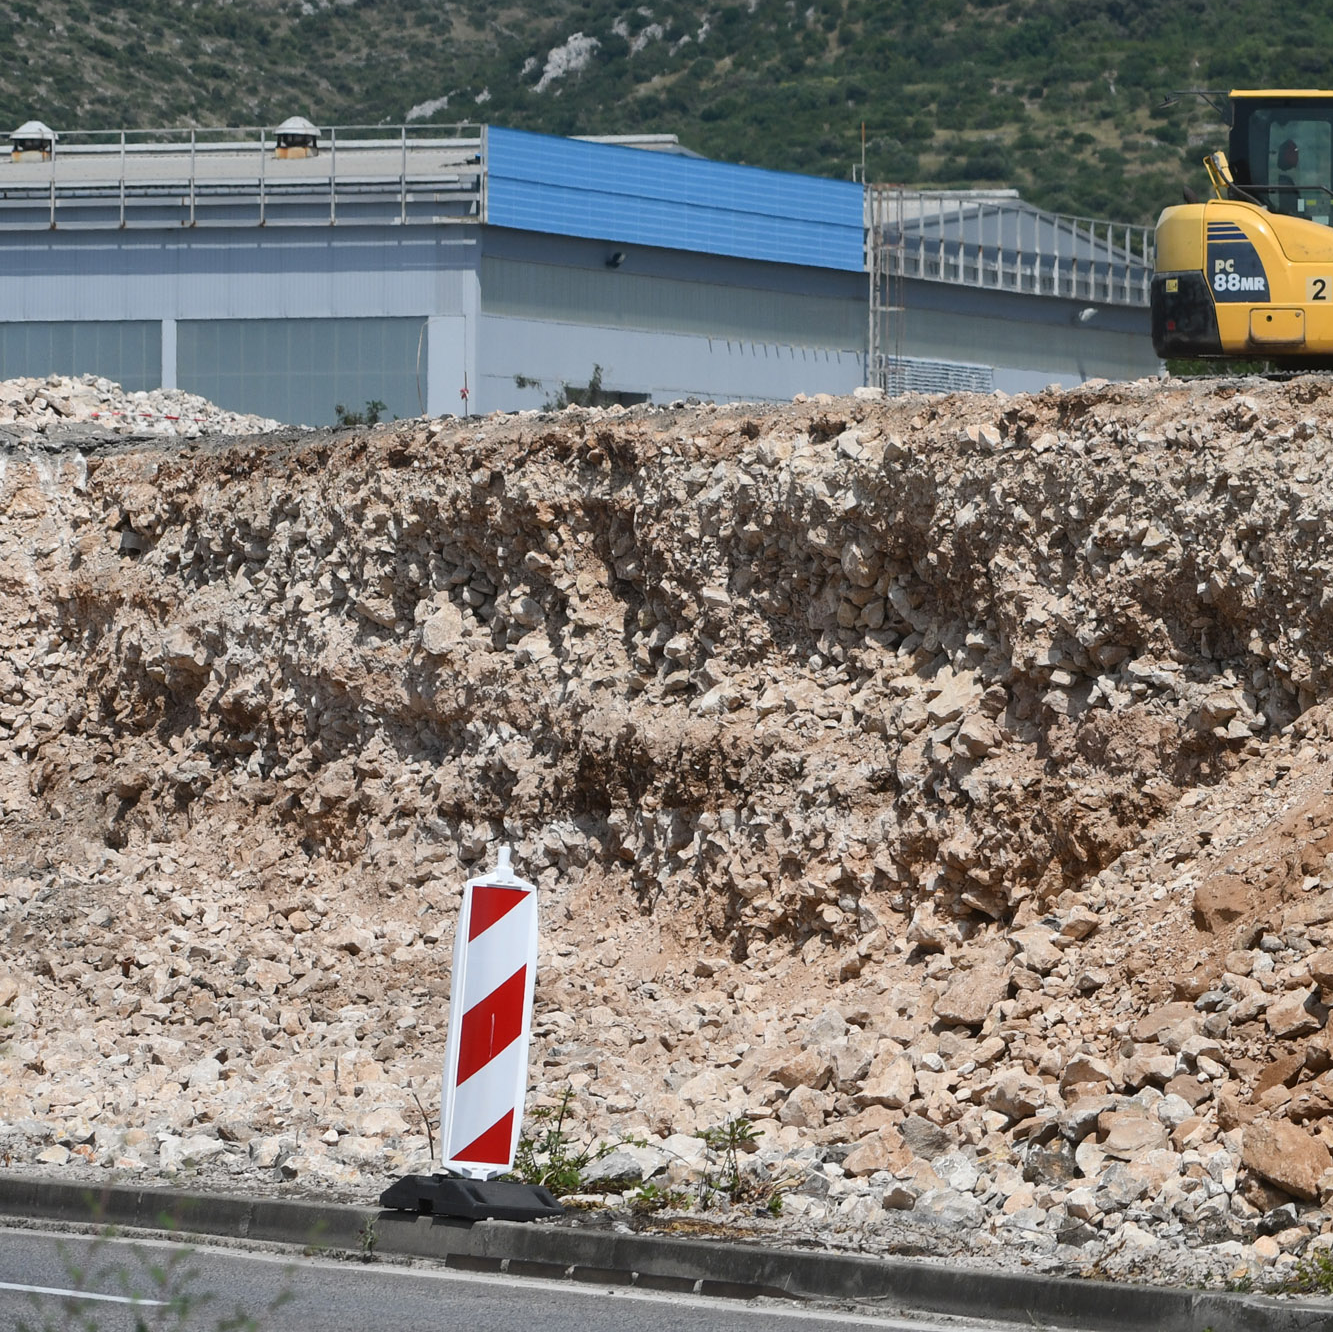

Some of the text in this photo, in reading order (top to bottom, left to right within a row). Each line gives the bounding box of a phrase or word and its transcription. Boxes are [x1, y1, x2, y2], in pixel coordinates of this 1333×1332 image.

[1214, 259, 1234, 273] PC
[1214, 273, 1265, 291] 88MR
[1312, 279, 1326, 300] 2
